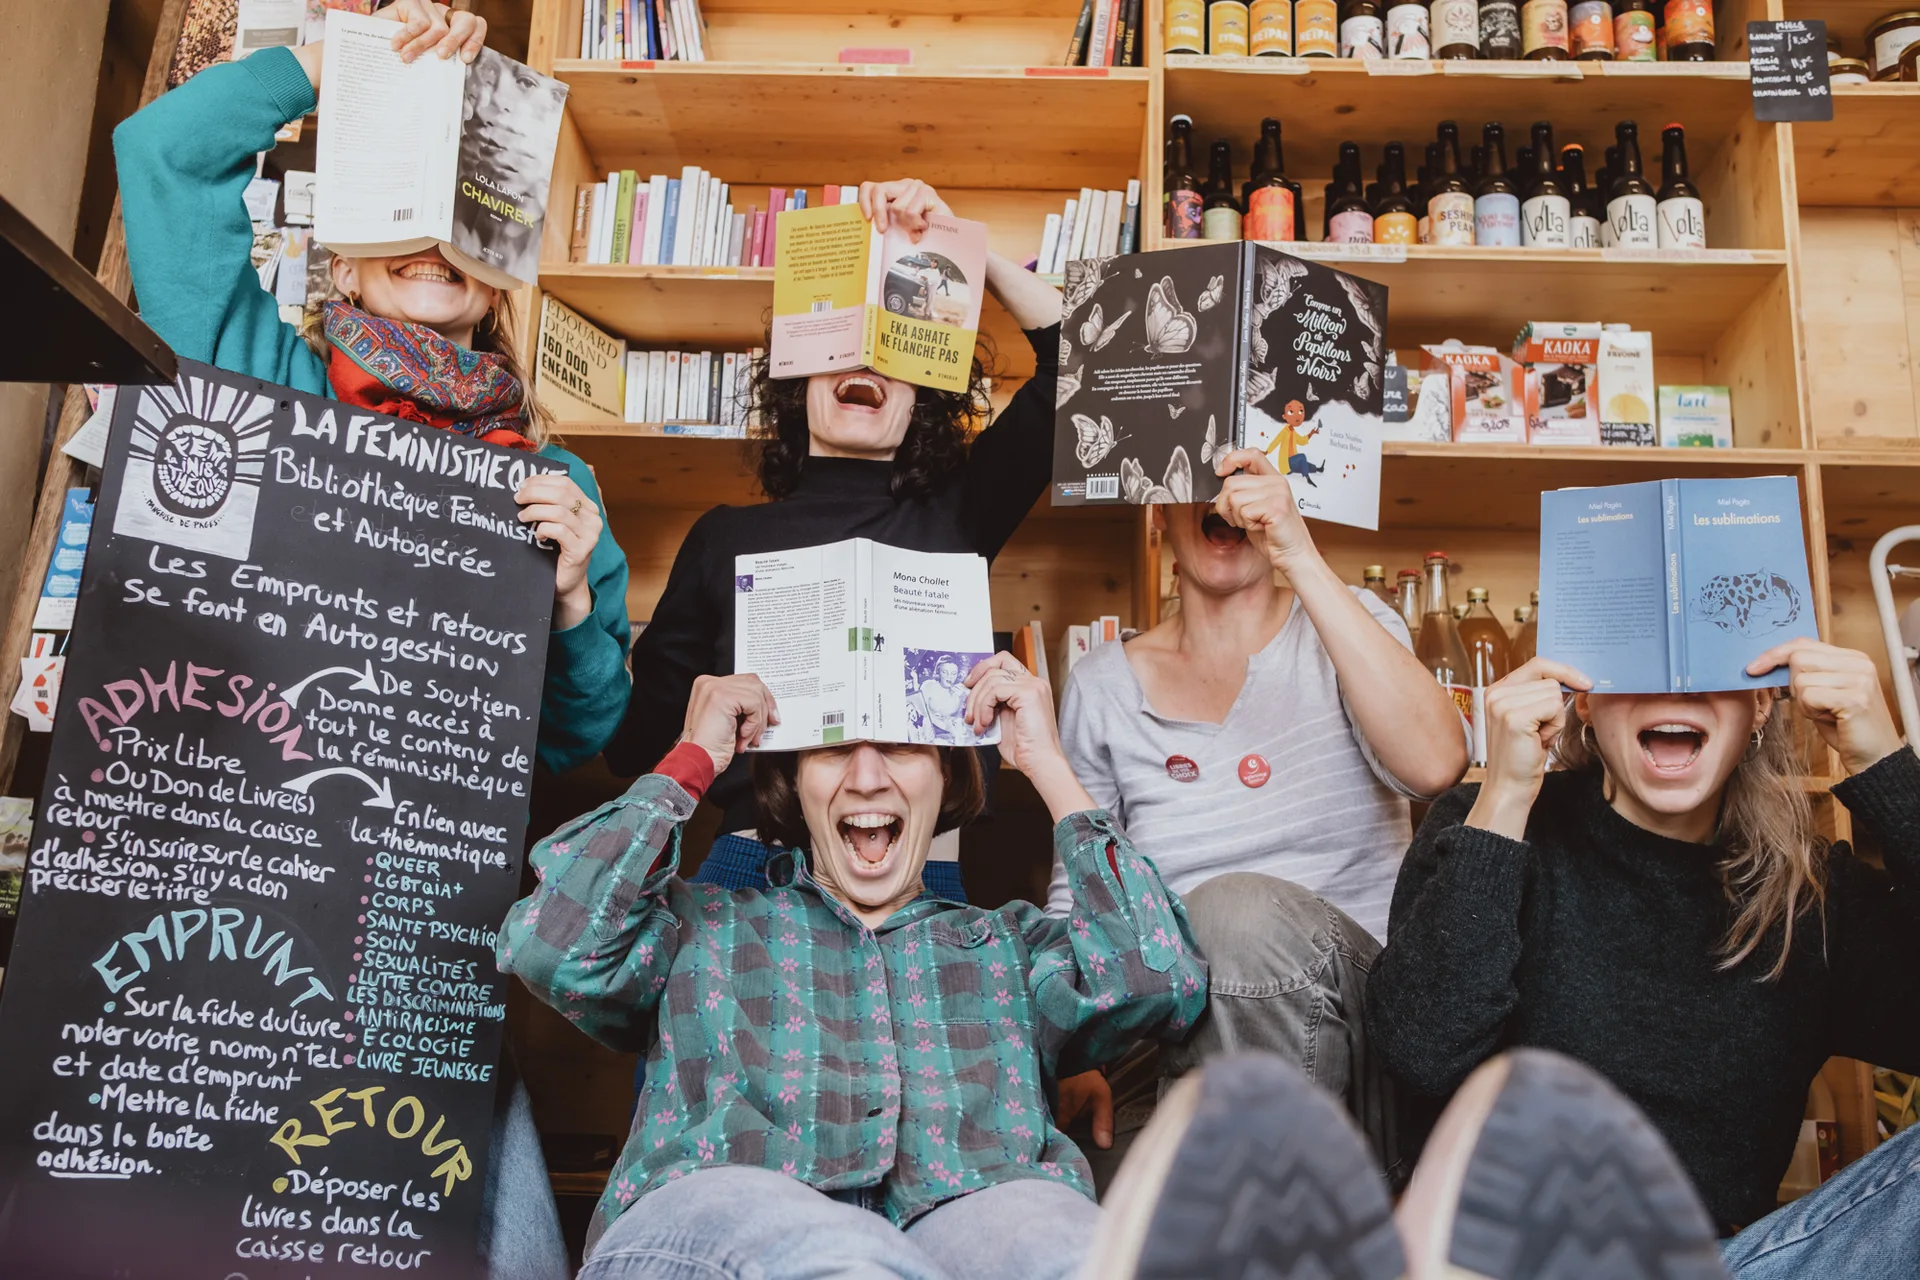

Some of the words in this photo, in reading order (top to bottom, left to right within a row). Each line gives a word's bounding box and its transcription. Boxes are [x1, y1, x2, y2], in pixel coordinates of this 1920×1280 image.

[475, 172, 496, 190] LOLA
[496, 182, 524, 203] LAFON
[462, 181, 535, 229] CHAVIRER
[1303, 293, 1332, 312] Comme
[1332, 306, 1342, 318] un
[547, 298, 618, 360] EDOUARD
[890, 320, 909, 337] EKA
[910, 325, 951, 347] ASHATE
[1293, 309, 1347, 341] Million
[1314, 332, 1323, 342] de
[543, 332, 561, 358] 160
[565, 346, 588, 377] 000
[545, 316, 607, 370] DURAND
[880, 331, 890, 349] NE
[892, 335, 936, 360] FLANCHE
[938, 347, 959, 365] PAS
[1293, 331, 1352, 362] Papillons
[1544, 339, 1590, 355] KAOKA
[541, 352, 593, 398] ENFANTS
[1296, 356, 1342, 382] Noirs
[1445, 354, 1490, 366] KAOKA
[291, 400, 337, 445] LA
[271, 446, 440, 522] Bibliothèque
[1577, 515, 1589, 523] Les
[1590, 512, 1633, 522] sublimations
[1693, 513, 1710, 526] Les
[1712, 512, 1781, 526] sublimations
[314, 507, 345, 532] et
[355, 517, 496, 577] Autogérée
[893, 571, 917, 583] Mona
[919, 575, 950, 587] Chollet
[893, 585, 922, 597] Beauté
[924, 590, 950, 600] fatale
[1669, 553, 1678, 599] sublimations
[149, 545, 207, 578] Les
[231, 564, 378, 619] Emprunts
[388, 599, 419, 628] et
[432, 612, 527, 655] retours
[184, 588, 247, 622] font
[258, 612, 287, 637] en
[902, 599, 925, 608] nouveaux
[909, 605, 934, 614] aliénation
[1671, 601, 1679, 615] Les
[380, 670, 412, 695] De
[317, 686, 396, 720] Donne
[479, 714, 495, 741] à
[108, 727, 170, 762] Prix
[306, 709, 357, 737] tout
[369, 720, 391, 745] le
[401, 734, 491, 763] contenu
[501, 746, 529, 774] de
[318, 737, 343, 762] la
[105, 761, 147, 789] Ou
[150, 768, 204, 798] Don
[209, 777, 235, 803] de
[1171, 771, 1197, 780] CHOIX
[46, 802, 131, 830] retour
[54, 773, 76, 802] à
[84, 788, 167, 820] mettre
[171, 801, 221, 829] dans
[222, 809, 247, 835] la
[250, 819, 322, 848] caisse
[394, 800, 420, 827] En
[424, 804, 455, 835] lien
[460, 823, 508, 845] avec
[351, 816, 380, 844] la
[378, 826, 507, 874] thématique
[199, 847, 242, 866] sur
[241, 844, 263, 871] le
[267, 854, 335, 884] cahier
[375, 851, 441, 878] QUEER
[128, 878, 150, 900] le
[151, 879, 212, 906] titre
[208, 870, 225, 893] y
[228, 872, 242, 889] a
[248, 874, 288, 901] don
[372, 892, 436, 916] CORPS
[366, 910, 426, 935] SANTE
[92, 907, 334, 1008] EMPRUNT
[346, 985, 378, 1006] LES
[358, 968, 414, 991] LUTTE
[417, 977, 493, 1002] CONTRE
[123, 986, 170, 1017] Sur
[172, 994, 196, 1025] la
[196, 998, 255, 1029] fiche
[259, 1006, 289, 1032] du
[61, 1018, 130, 1047] noter
[133, 1026, 200, 1056] votre
[52, 1050, 92, 1077] et
[99, 1054, 163, 1082] date
[411, 1056, 494, 1082] JEUNESSE
[100, 1083, 190, 1117] Mettre
[195, 1092, 221, 1120] la
[225, 1095, 280, 1125] fiche
[33, 1110, 103, 1147] dans
[113, 1122, 137, 1147] la
[147, 1122, 214, 1152] boîte
[267, 1086, 473, 1197] RETOUR
[287, 1166, 398, 1204] Déposer
[321, 1206, 380, 1236] dans
[236, 1235, 325, 1264] caisse
[337, 1242, 431, 1270] retour
